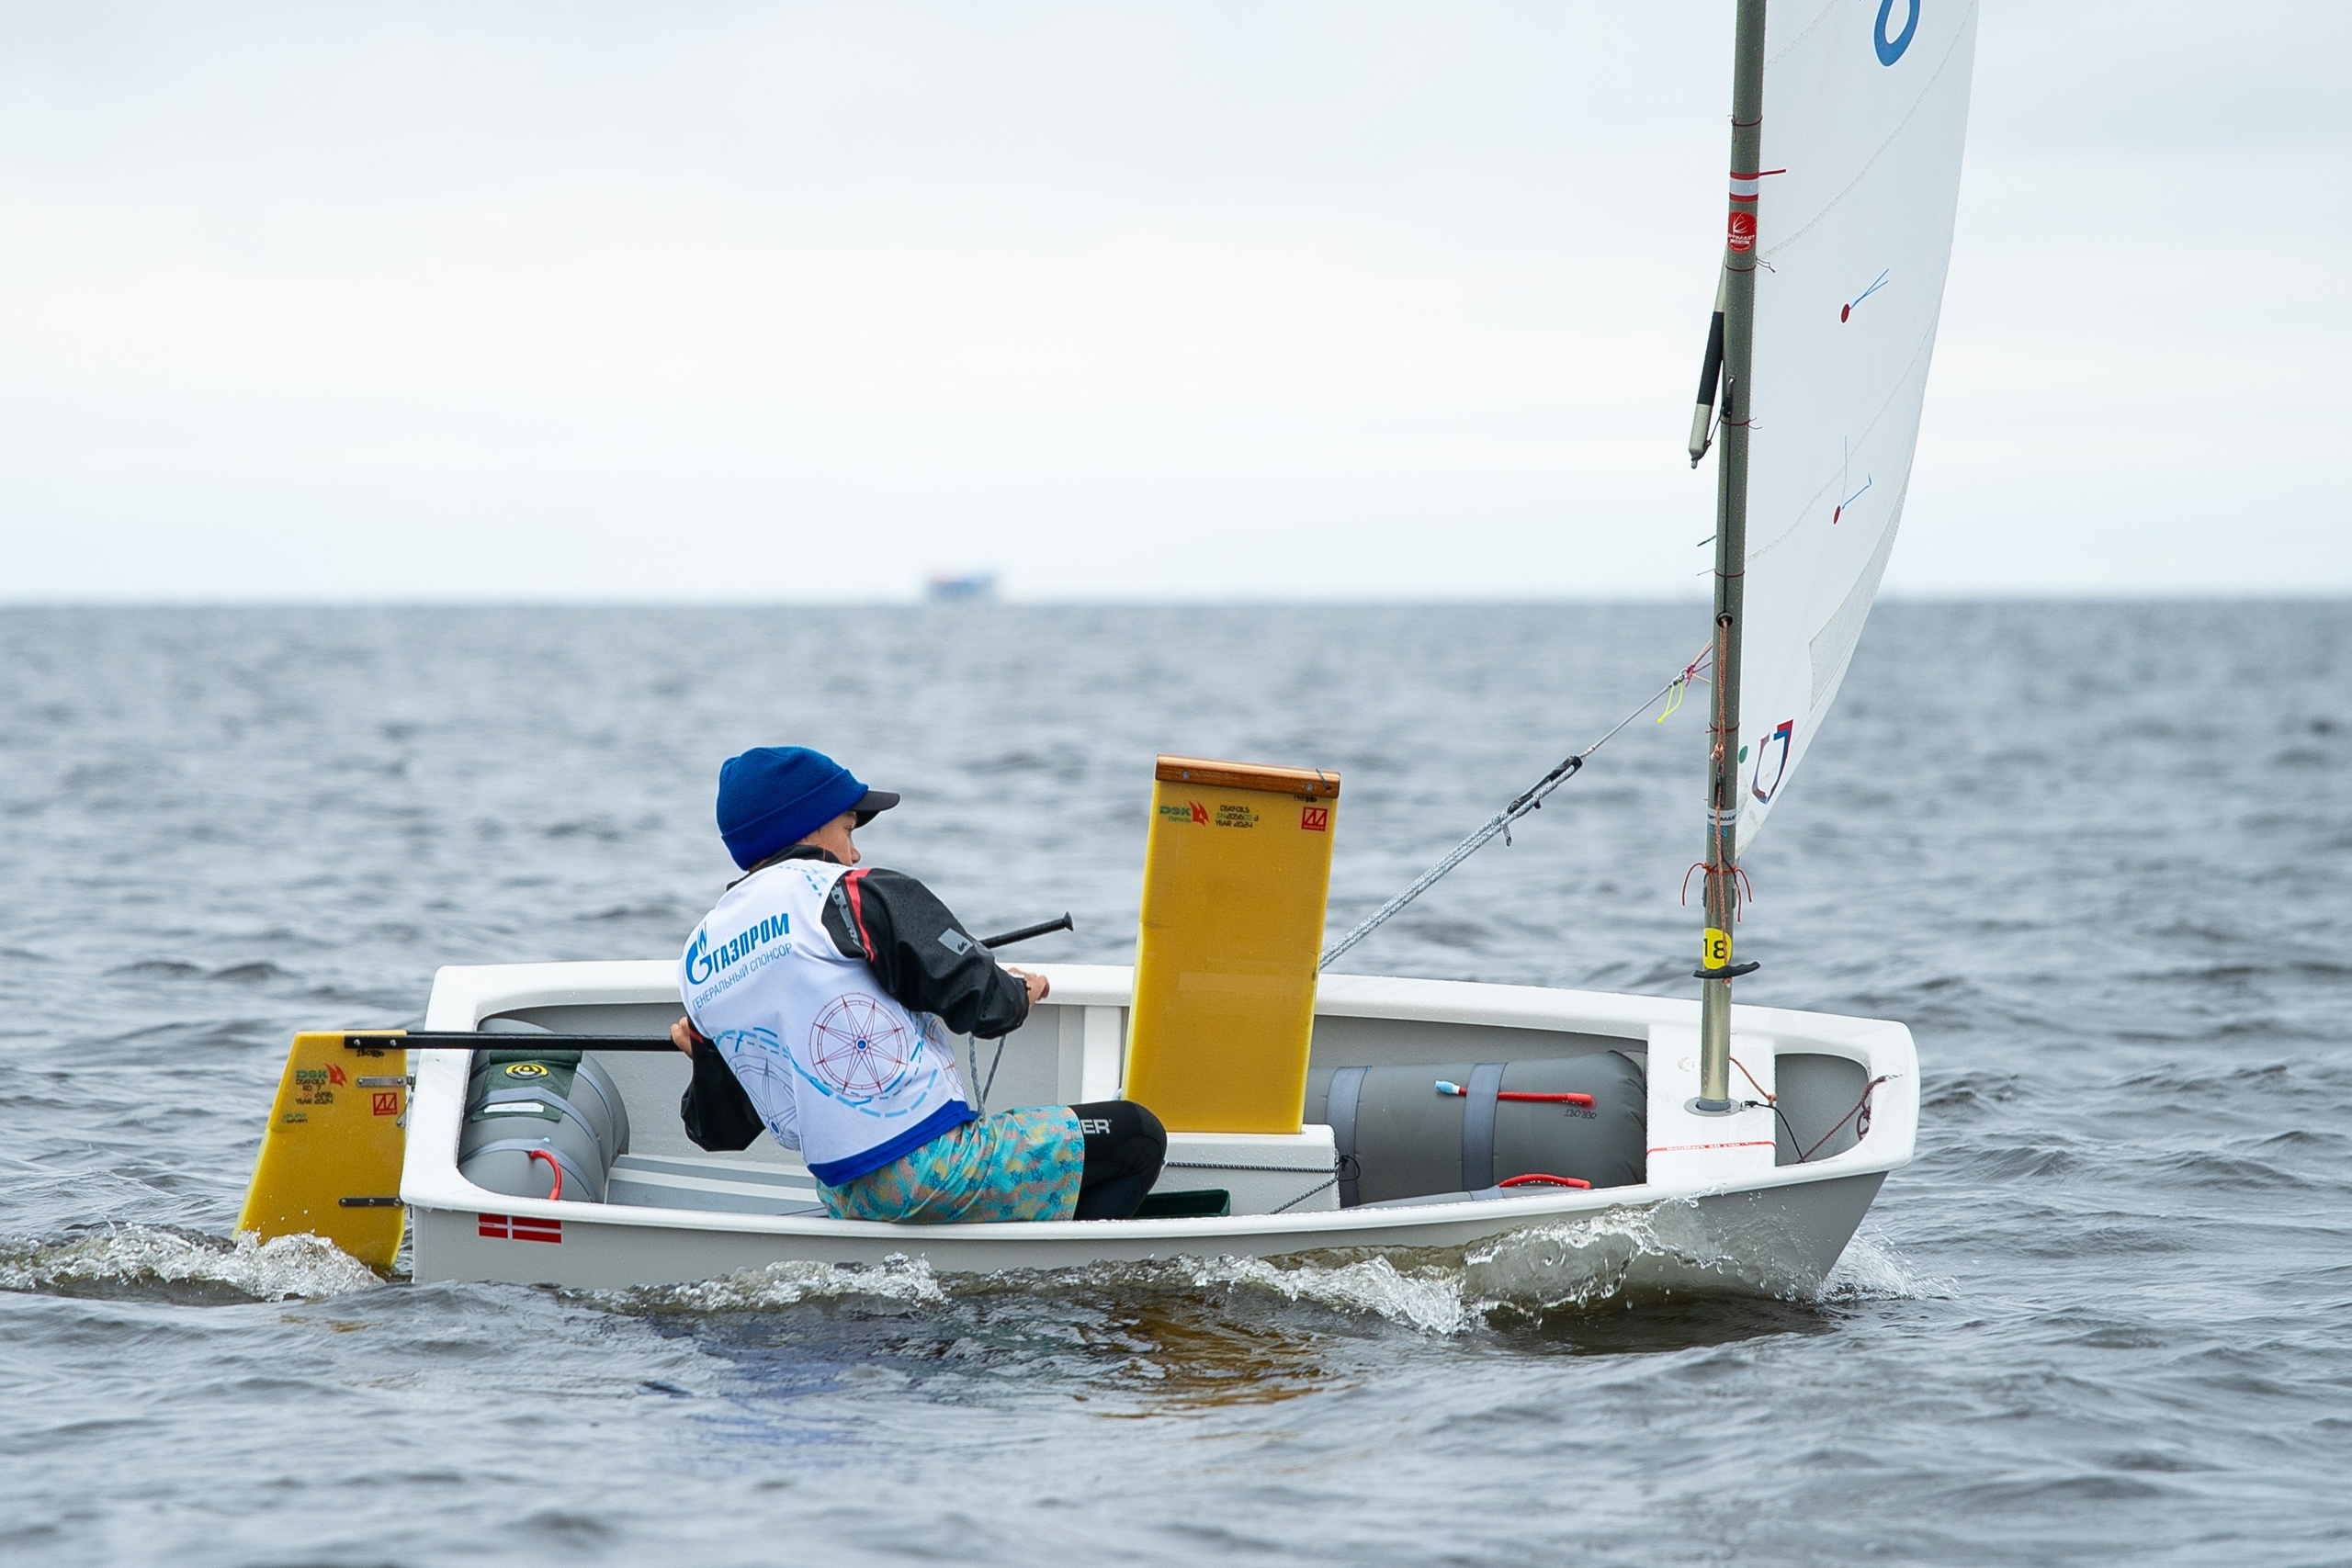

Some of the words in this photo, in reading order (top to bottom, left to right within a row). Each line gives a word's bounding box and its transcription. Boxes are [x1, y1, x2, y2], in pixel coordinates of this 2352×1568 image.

[1159, 806, 1191, 816] DSK
[1215, 819, 1232, 828] YEAR
[1234, 820, 1253, 829] 2024
[713, 913, 790, 974] ГАЗПРОМ
[1703, 938, 1727, 960] 18
[692, 963, 750, 1011] ГЕНЕРАЛЬНЫЙ
[750, 942, 793, 973] СПОНСОР
[296, 1070, 328, 1078] DSK
[1080, 1119, 1110, 1134] ER
